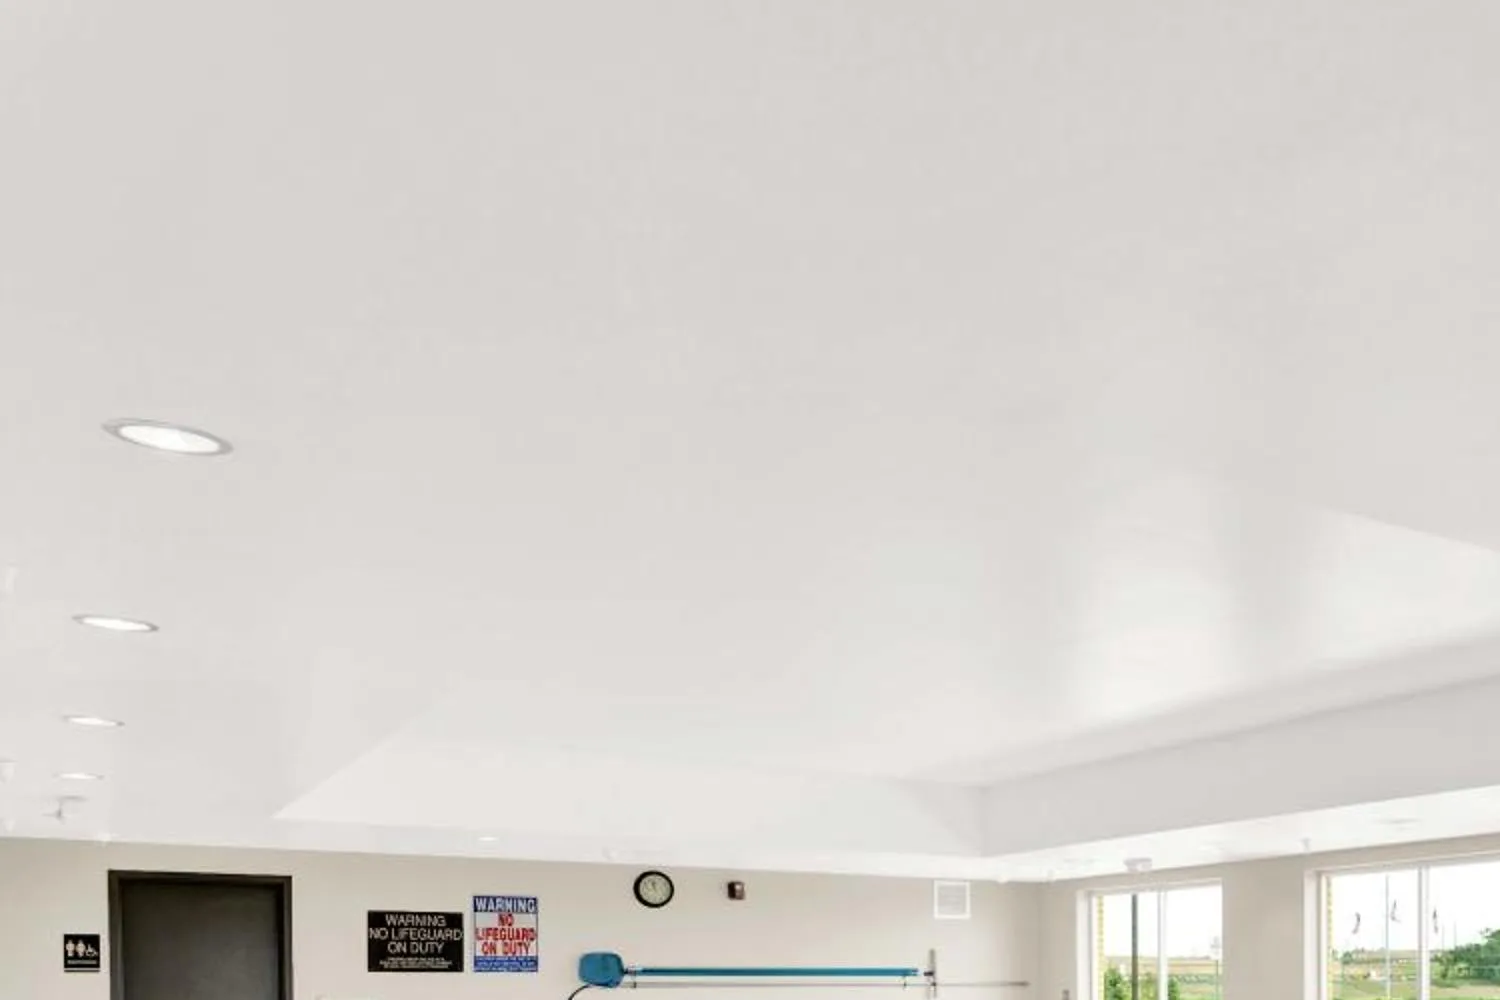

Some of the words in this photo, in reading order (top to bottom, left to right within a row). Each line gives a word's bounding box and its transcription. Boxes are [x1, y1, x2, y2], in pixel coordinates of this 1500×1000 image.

[475, 897, 536, 912] WARNING
[385, 914, 447, 927] WARNING
[498, 913, 514, 926] NO
[369, 927, 389, 940] NO
[391, 927, 463, 941] LIFEGUARD
[475, 927, 536, 941] LIFEGUARD
[387, 941, 407, 953] ON
[410, 941, 445, 954] DUTY
[481, 942, 497, 955] ON
[503, 942, 531, 955] DUTY
